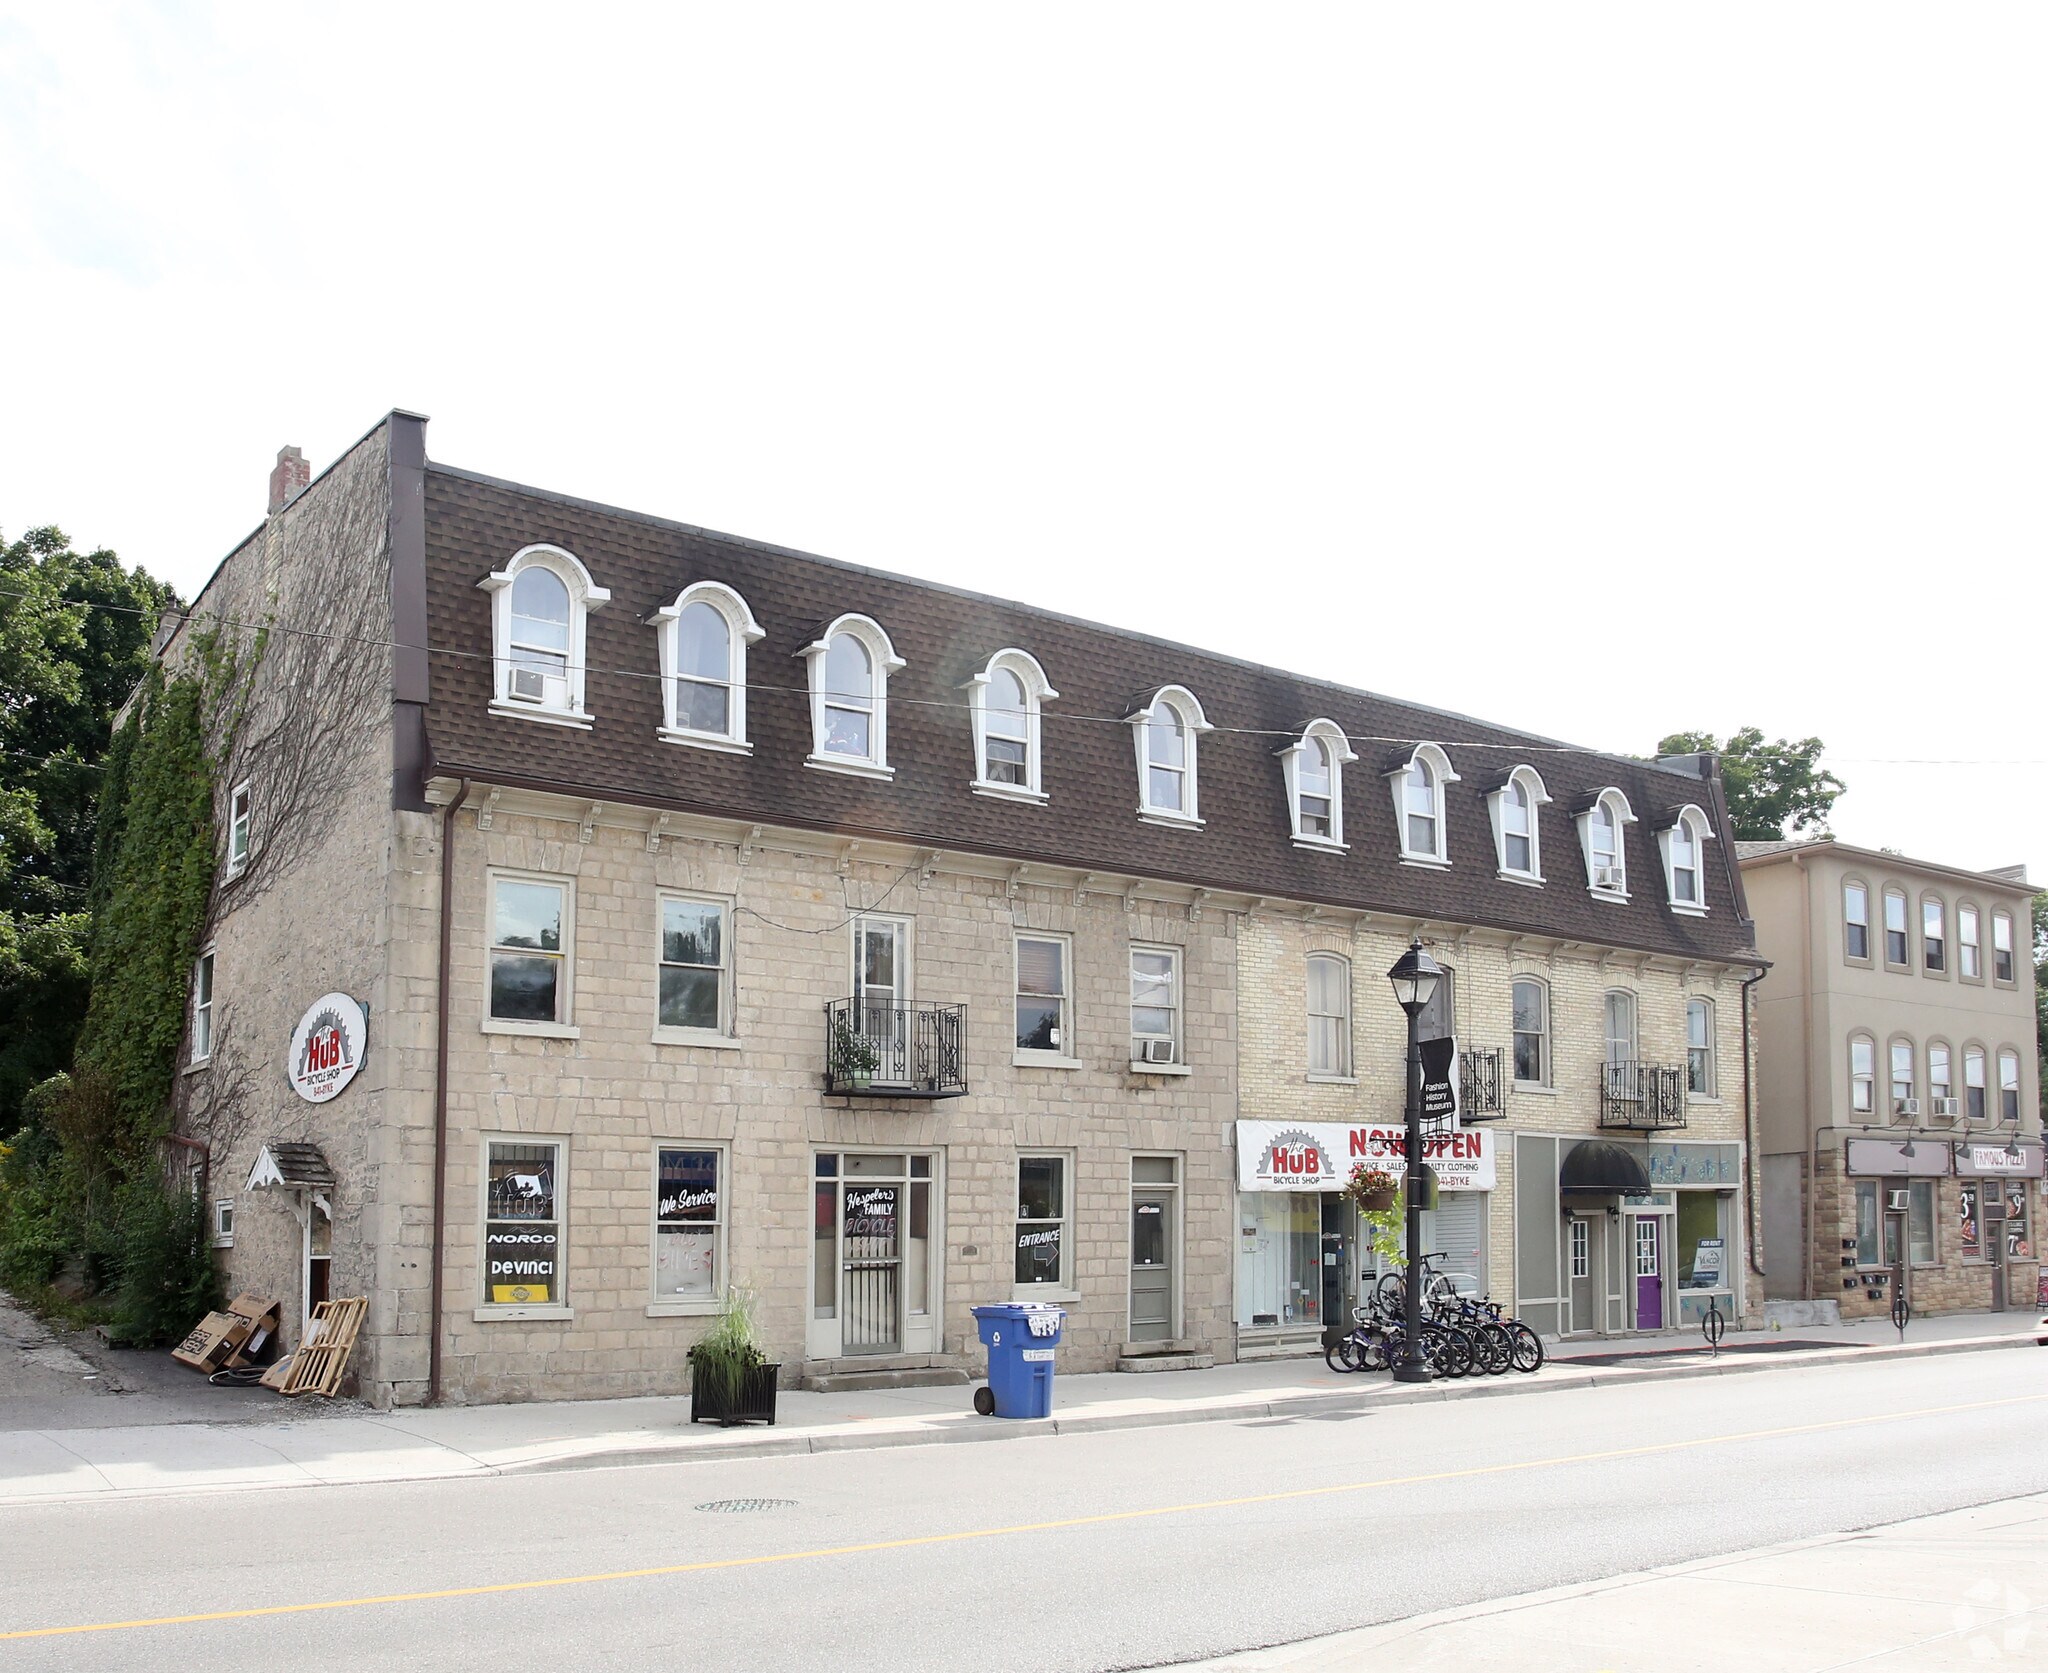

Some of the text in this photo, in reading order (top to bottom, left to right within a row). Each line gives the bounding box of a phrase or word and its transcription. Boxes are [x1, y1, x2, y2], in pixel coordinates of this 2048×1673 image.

[307, 1067, 341, 1086] BICYCLE SHOP
[1425, 1082, 1449, 1092] Fashion
[1425, 1092, 1448, 1102] History
[1425, 1101, 1452, 1112] Museum
[1975, 1150, 2003, 1166] FAMOUS
[1386, 1162, 1406, 1171] SALES
[1448, 1163, 1479, 1171] CLOTHING
[1273, 1176, 1321, 1185] BICYCLE SHOP
[659, 1188, 717, 1216] We Service
[846, 1187, 895, 1212] Hespeler's
[864, 1203, 894, 1215] FAMILY
[487, 1234, 557, 1244] NORCO
[1018, 1229, 1060, 1248] ENTRANCE
